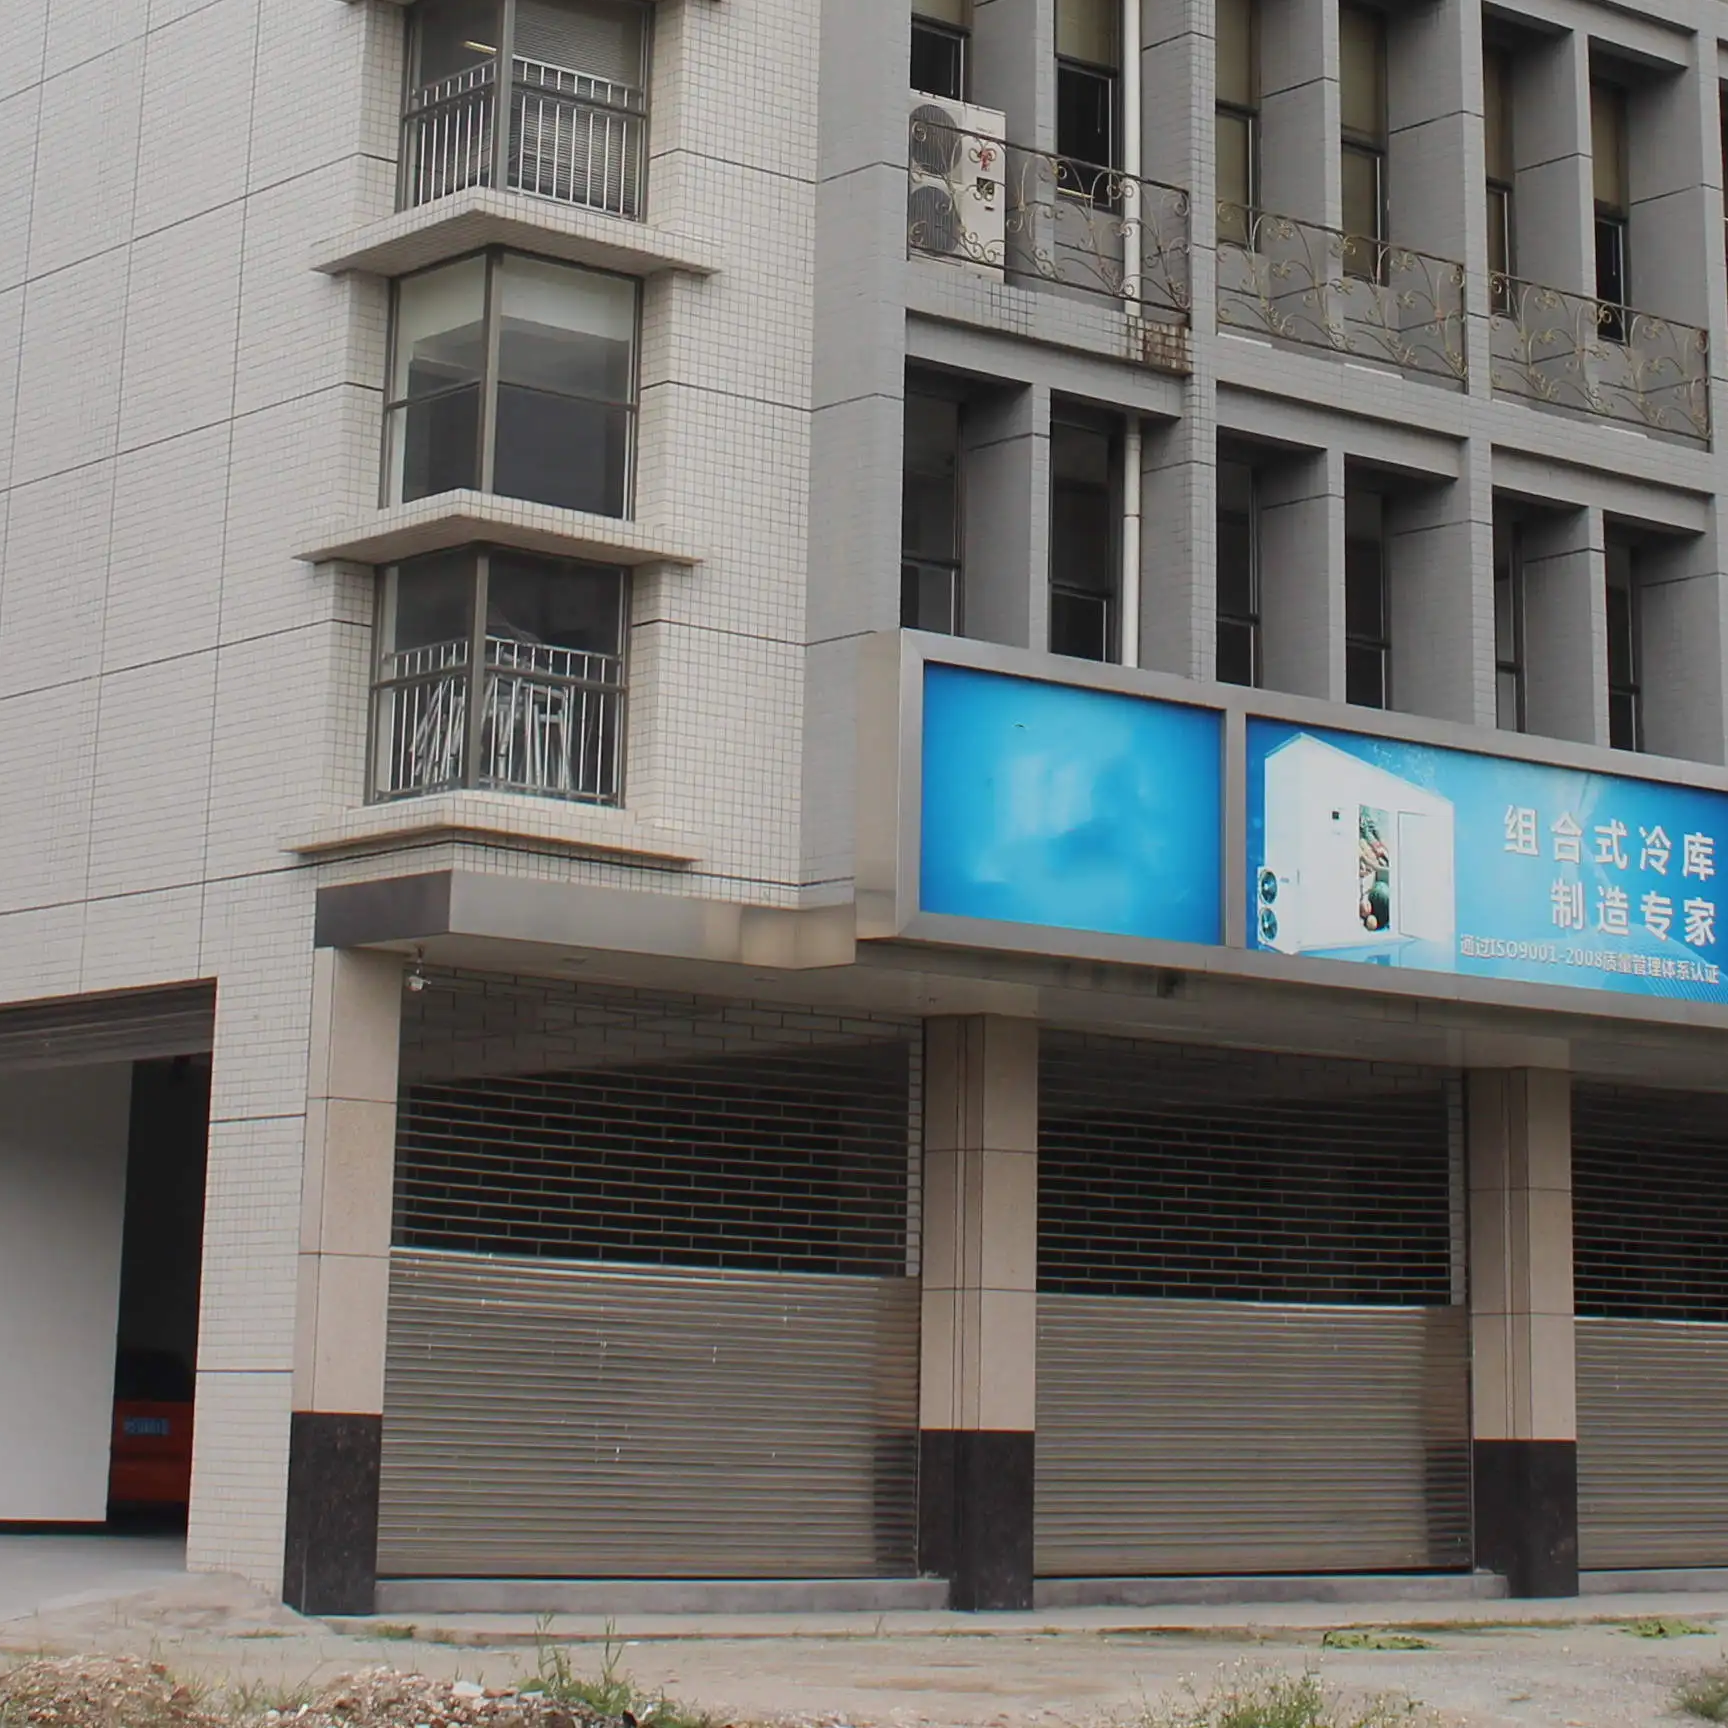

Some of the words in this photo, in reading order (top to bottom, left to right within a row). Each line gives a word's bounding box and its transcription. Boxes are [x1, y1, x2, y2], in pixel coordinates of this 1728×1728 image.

[1503, 804, 1716, 881] 组合式冷库
[1550, 876, 1716, 947] 制造专家
